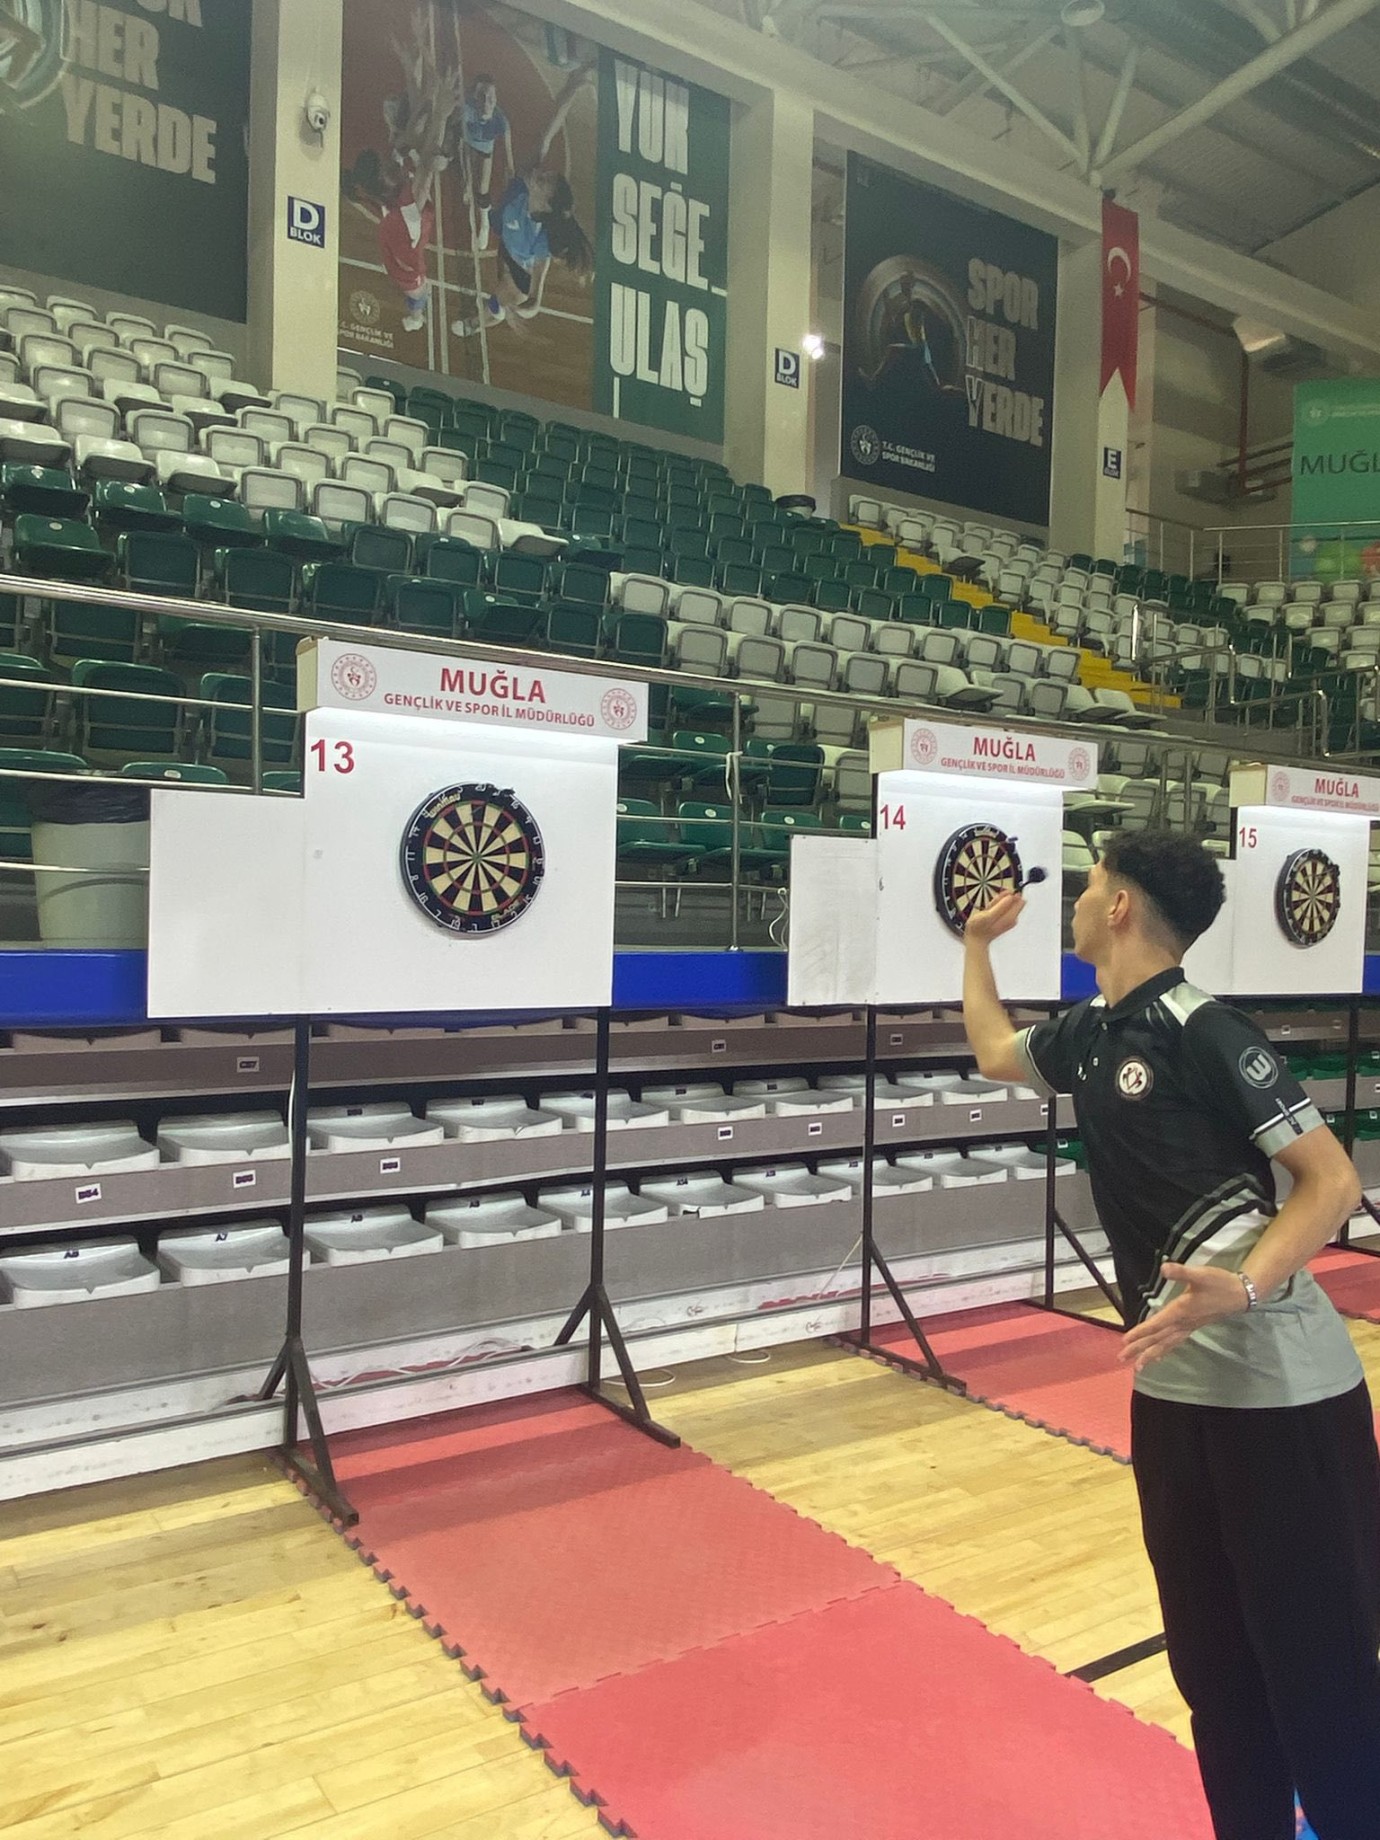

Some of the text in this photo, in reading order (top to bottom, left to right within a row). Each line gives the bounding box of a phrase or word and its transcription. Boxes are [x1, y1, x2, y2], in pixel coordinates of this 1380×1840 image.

[60, 0, 159, 90] HER
[61, 70, 217, 184] YERDE
[293, 199, 320, 230] D
[290, 226, 322, 245] BLOK
[968, 257, 1039, 330] SPOR
[610, 282, 708, 407] ULAŞ
[966, 315, 1017, 381] HER
[779, 350, 796, 375] D
[776, 372, 797, 387] BLOK
[965, 374, 1044, 447] YERDE
[1107, 450, 1117, 470] E
[440, 667, 546, 703] MUĞLA
[384, 692, 595, 727] GENÇLİK VE SPOR İL MÜDÜRLÜĞÜ
[310, 739, 354, 774] 13
[973, 736, 1036, 761] MUĞLA
[941, 757, 975, 771] GENÇLİK
[976, 761, 986, 771] VE
[987, 762, 1008, 773] SPOR
[1315, 778, 1359, 798] MUĞLA
[880, 804, 906, 830] 14
[1239, 827, 1257, 848] 15
